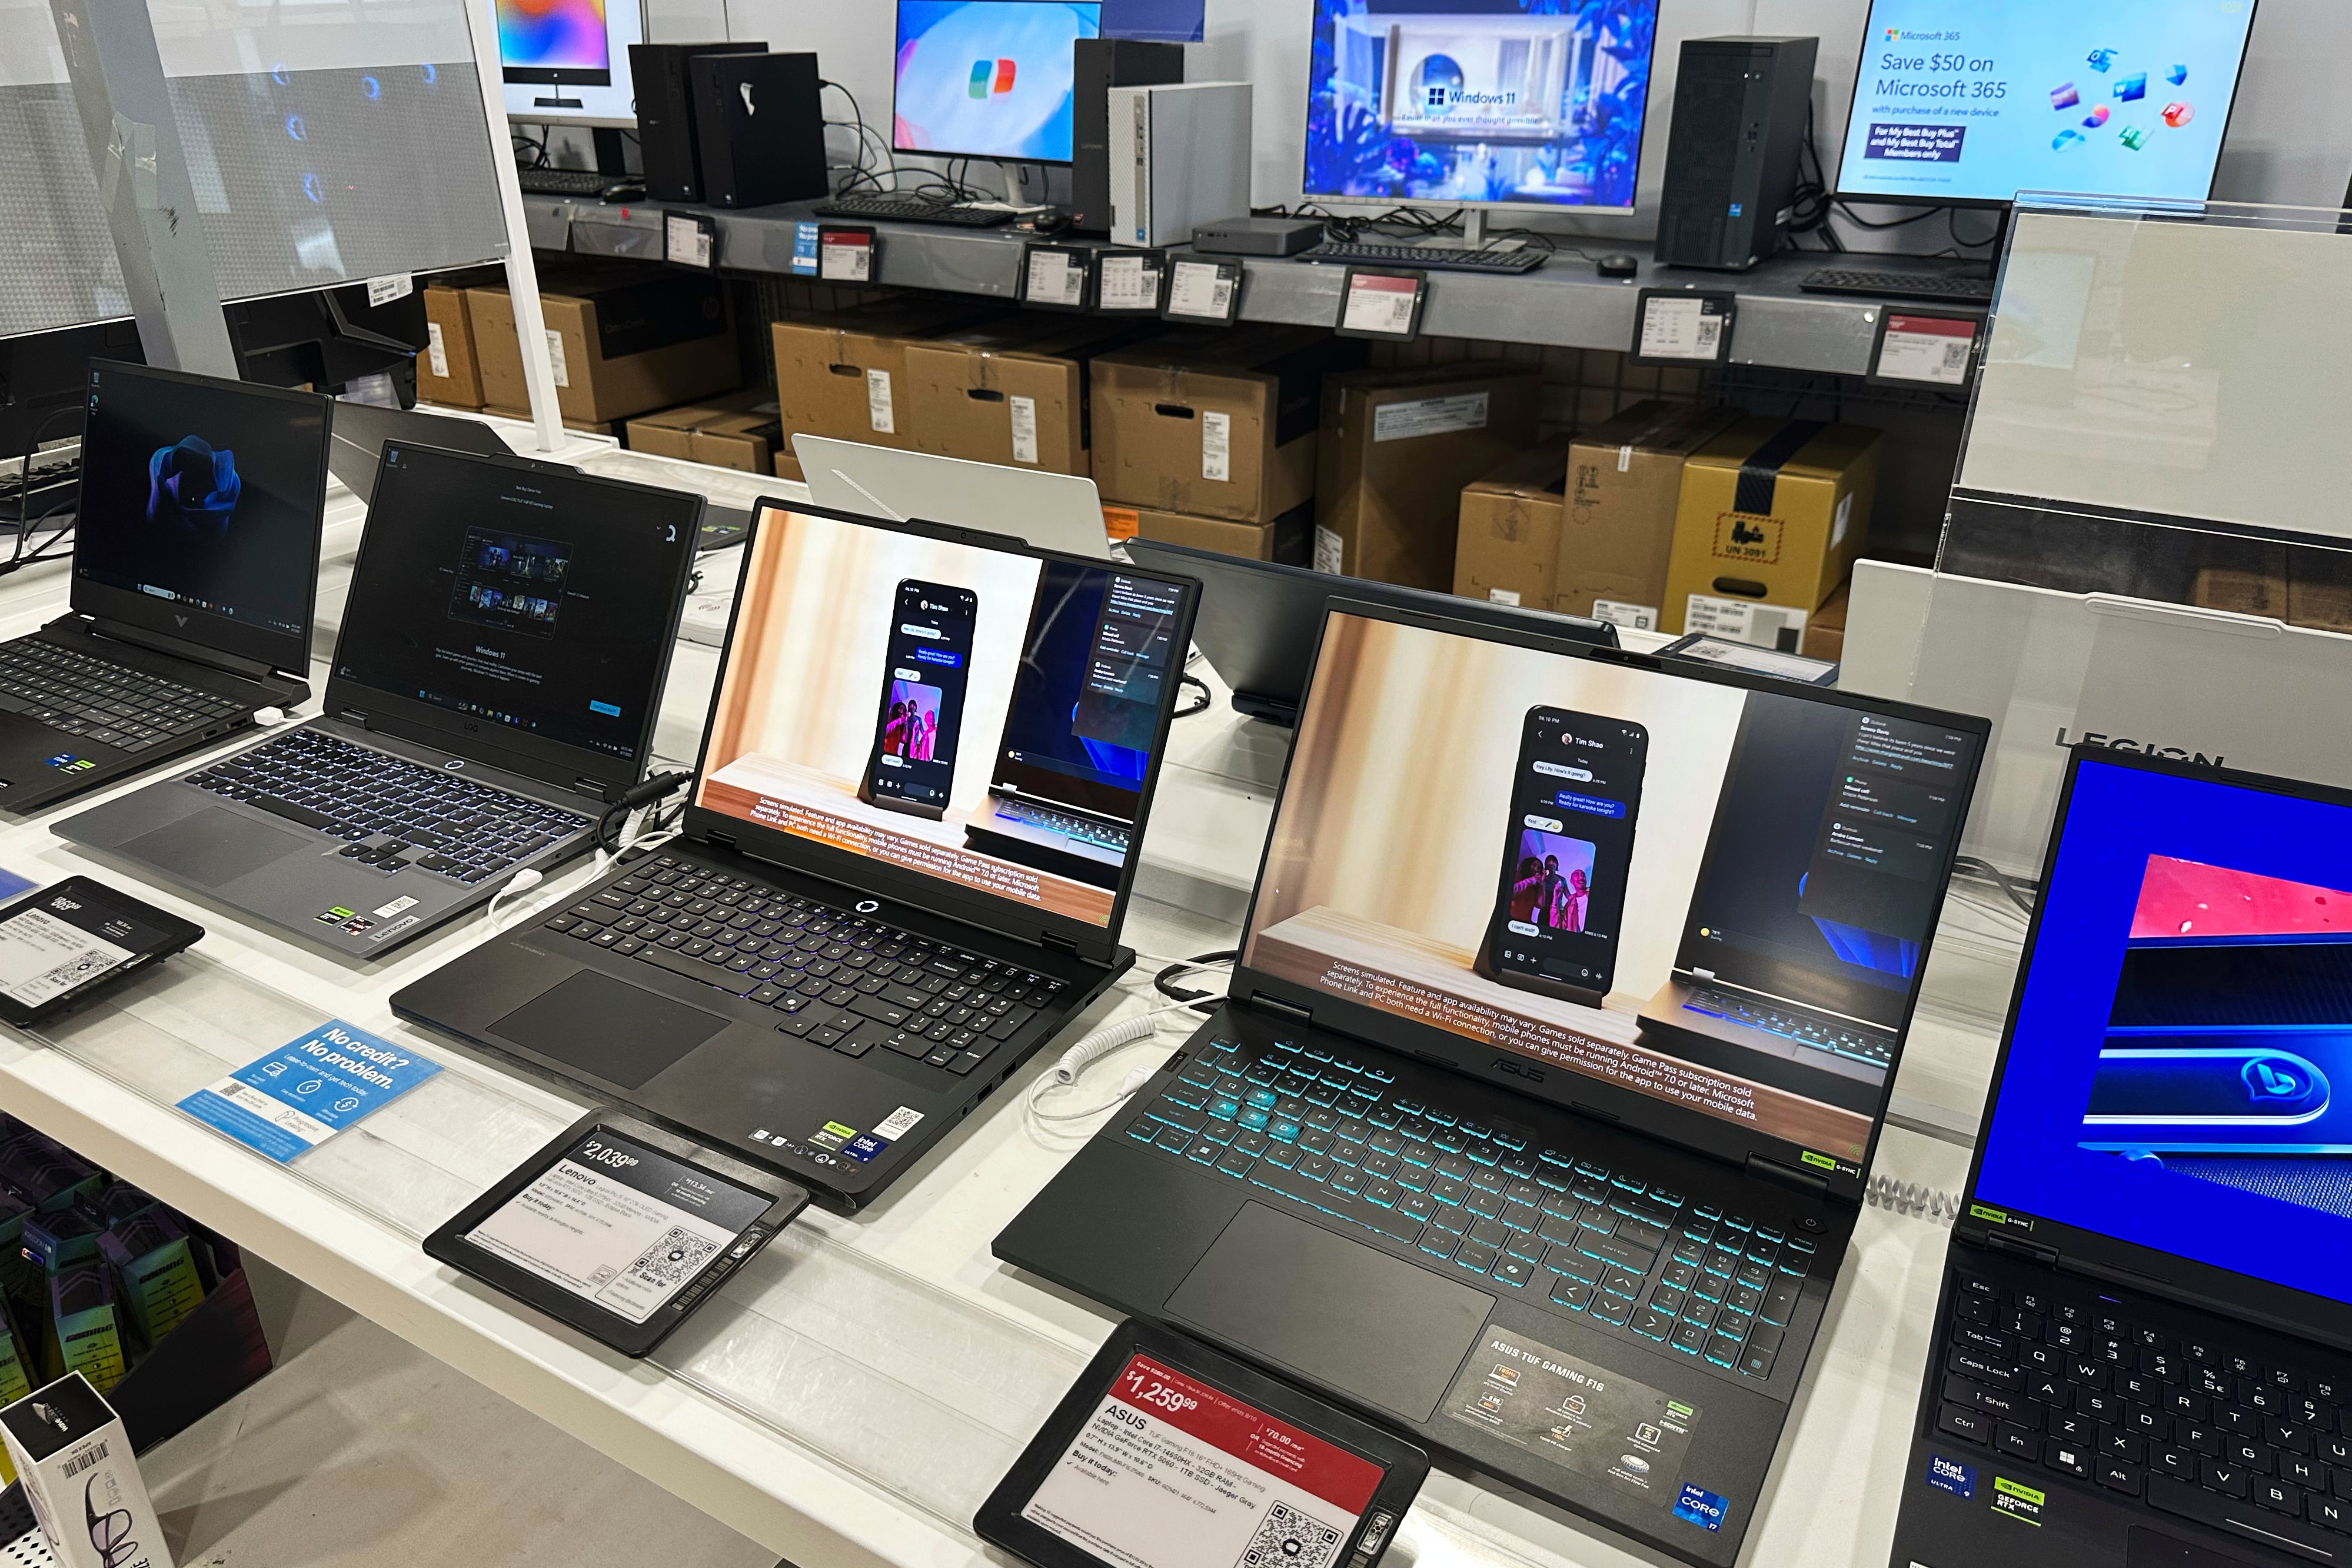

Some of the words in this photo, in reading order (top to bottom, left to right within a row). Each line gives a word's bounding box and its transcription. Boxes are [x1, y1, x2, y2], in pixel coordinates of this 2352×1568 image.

[1900, 31, 1942, 41] Microsoft
[1944, 32, 1960, 41] 365
[1881, 54, 1924, 71] Save
[1929, 53, 1965, 73] $50
[1969, 59, 1994, 72] on
[1875, 79, 1967, 98] Microsoft
[1971, 81, 2007, 99] 365
[1449, 91, 1503, 104] Windows
[1506, 92, 1515, 104] 11
[1872, 105, 1891, 114] with
[1891, 106, 1931, 116] purchase
[1970, 108, 2000, 117] device
[1726, 545, 1740, 555] UN
[475, 645, 499, 658] Windows
[1575, 737, 1588, 746] Tim
[25, 911, 50, 925] Lenovo
[374, 917, 414, 940] Lenovo
[1332, 961, 1359, 976] Screens
[1360, 971, 1395, 987] simulated.
[1398, 981, 1426, 996] Feature
[1426, 992, 1442, 1001] and
[1442, 997, 1458, 1008] app
[1458, 1002, 1499, 1021] availability
[1500, 1015, 1517, 1027] may
[1518, 1020, 1536, 1032] vary.
[1538, 1024, 1566, 1040] Games
[1567, 1036, 1585, 1046] sold
[1586, 1041, 1629, 1061] separately.
[1631, 1053, 1657, 1068] Game
[1658, 1061, 1677, 1074] Pass
[1678, 1070, 1731, 1090] subscription
[1732, 1086, 1752, 1097] sold
[1326, 971, 1362, 988] separately.
[1365, 981, 1373, 990] To
[1374, 986, 1414, 1003] experience
[1415, 996, 1428, 1007] the
[1428, 1000, 1441, 1011] full
[1442, 1004, 1491, 1028] functionality,
[1492, 1022, 1519, 1035] mobile
[1519, 1030, 1550, 1044] phones
[1551, 1040, 1572, 1051] must
[1573, 1045, 1585, 1056] be
[1585, 1051, 1618, 1068] running
[1664, 1073, 1676, 1084] 7.0
[1689, 1081, 1709, 1094] later.
[1712, 1088, 1755, 1108] Microsoft
[322, 1028, 350, 1045] No
[345, 1041, 410, 1070] credit?
[300, 1039, 328, 1056] No
[318, 1052, 393, 1090] problem.
[318, 1068, 330, 1079] and
[330, 1075, 340, 1085] get
[819, 1131, 844, 1143] GEFORCE
[857, 1136, 877, 1147] intel
[844, 1150, 858, 1158] ULTRA
[558, 1164, 597, 1186] Lenovo
[1836, 1164, 1856, 1174] G-SYNC
[1982, 1212, 2003, 1220] NVIDIA
[2007, 1217, 2029, 1227] G-SYNC
[640, 1272, 656, 1283] Scan
[655, 1279, 667, 1288] for
[1972, 1282, 1990, 1292] Esc
[1966, 1330, 1983, 1341] Tab
[1136, 1361, 1150, 1372] Save
[1491, 1340, 1519, 1357] ASUS
[1521, 1351, 1541, 1366] TUF
[1542, 1360, 1585, 1384] GAMING
[1586, 1377, 1605, 1391] F16
[1960, 1357, 1984, 1370] Caps
[1987, 1365, 2010, 1378] Lock
[1217, 1400, 1232, 1410] Offer
[1231, 1407, 1245, 1417] ends
[1985, 1396, 2010, 1410] Shift
[1105, 1405, 1147, 1430] ASUS
[1955, 1417, 1974, 1429] Ctrl
[1250, 1433, 1260, 1442] OR
[1266, 1427, 1291, 1445] $70.00
[2011, 1435, 2024, 1446] Fn
[1072, 1450, 1088, 1462] Buy
[1087, 1456, 1095, 1464] it
[1096, 1416, 1119, 1431] Laptop
[1122, 1429, 1138, 1439] Intel
[1136, 1436, 1153, 1447] Core
[1195, 1465, 1216, 1477] 32GB
[1215, 1475, 1233, 1486] RAM
[1091, 1423, 1115, 1437] NVIDIA
[1113, 1434, 1141, 1450] GeForce
[1141, 1447, 1157, 1459] RTX
[1157, 1456, 1175, 1467] 5060
[1179, 1467, 1194, 1477] 1TB
[1193, 1474, 1210, 1485] SSD
[1214, 1484, 1237, 1499] Jaeger
[1237, 1496, 1255, 1509] Gray
[1934, 1457, 1962, 1475] intel
[1074, 1464, 1097, 1480] Available
[1097, 1476, 1109, 1486] here
[2110, 1470, 2126, 1480] Alt
[1685, 1485, 1704, 1497] intel
[1931, 1479, 1953, 1492] ULTRA
[2012, 1487, 2039, 1500] NVIDIA
[1997, 1500, 2015, 1511] RTX
[1998, 1494, 2038, 1513] GEFORCE
